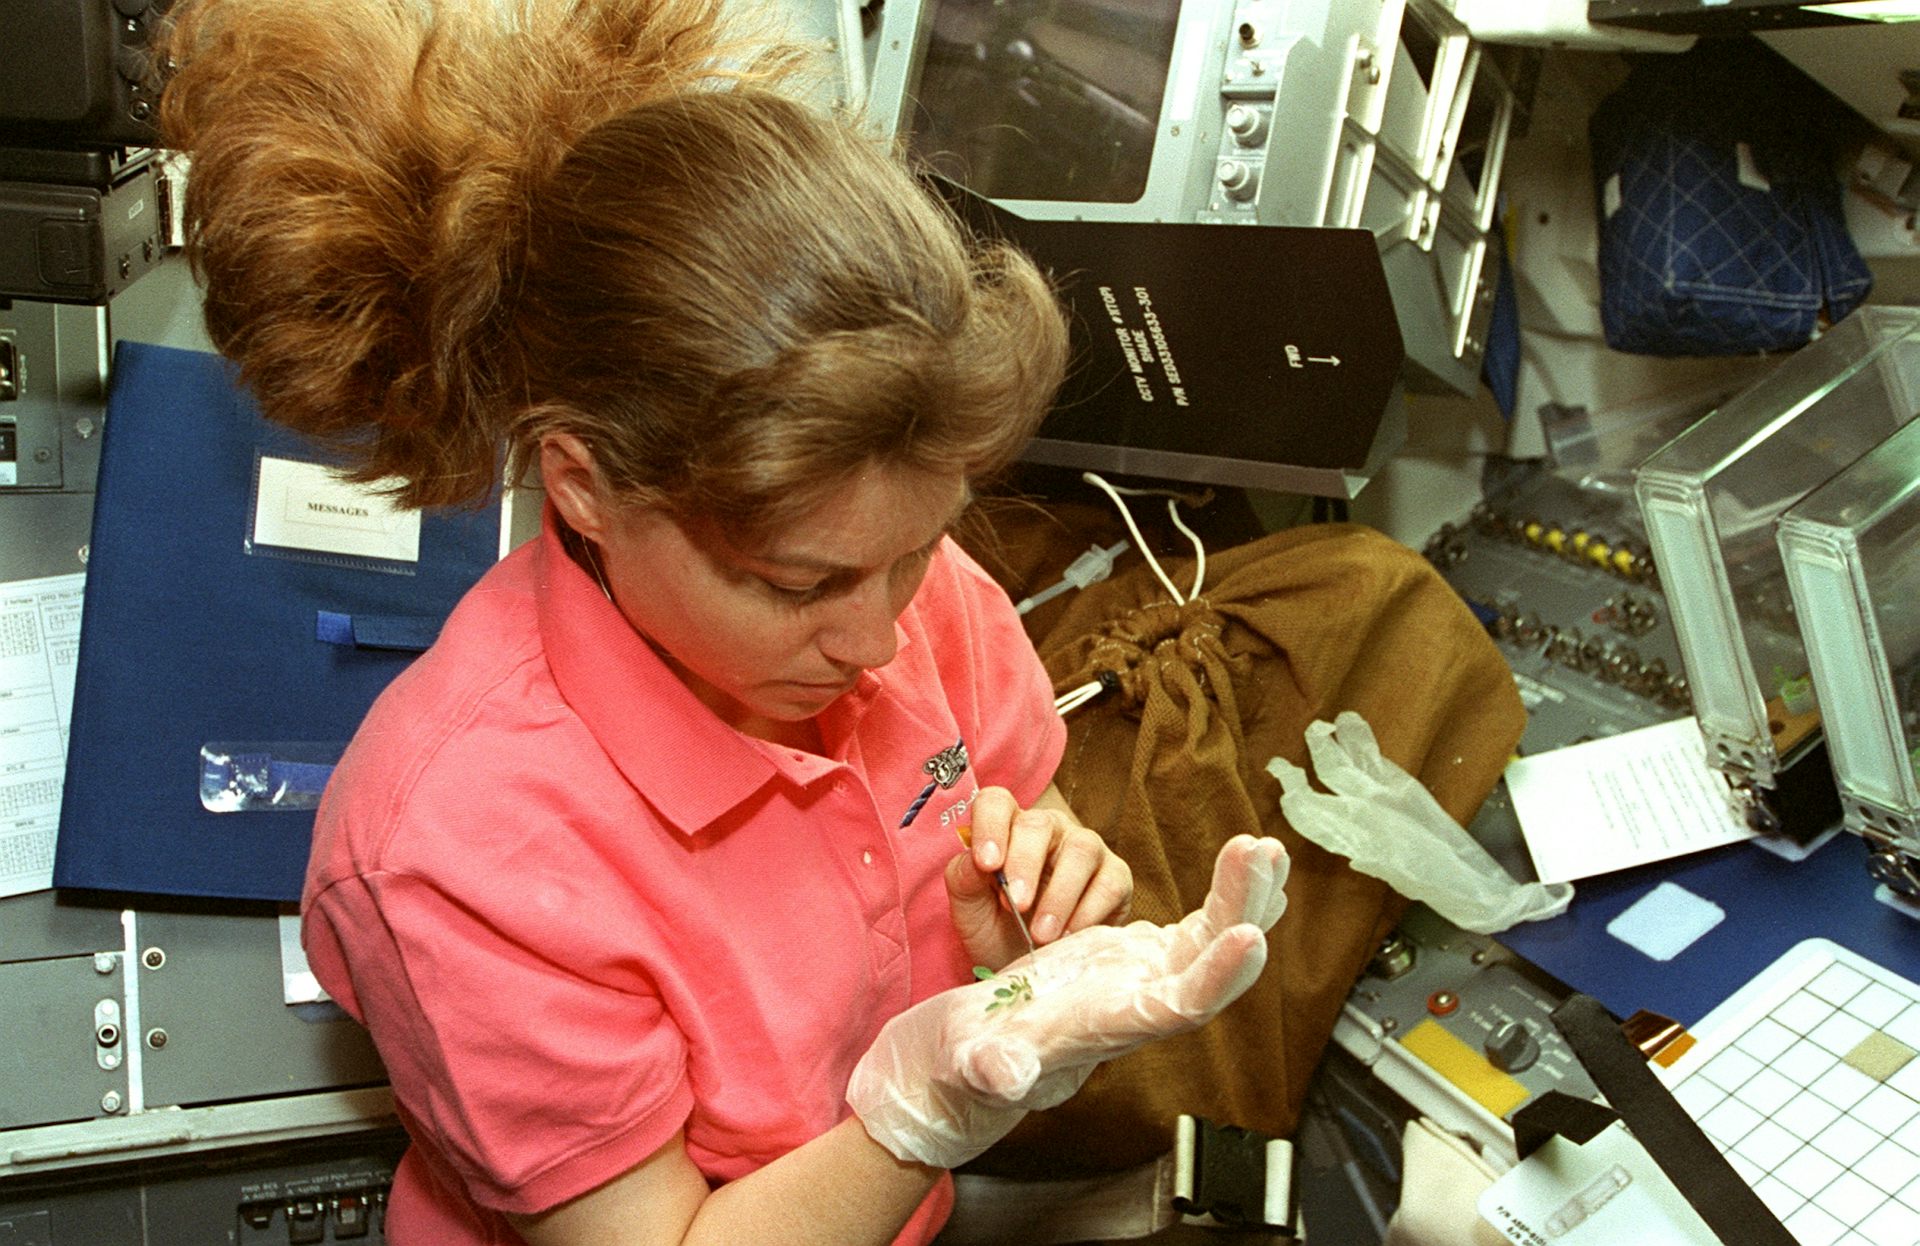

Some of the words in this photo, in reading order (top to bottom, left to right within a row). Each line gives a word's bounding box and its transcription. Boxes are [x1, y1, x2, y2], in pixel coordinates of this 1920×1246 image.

[1115, 327, 1143, 373] MONITOR
[1131, 329, 1155, 363] SHADE
[1285, 344, 1303, 368] FWD
[1134, 375, 1154, 402] CCTV
[1172, 386, 1189, 406] P/N
[308, 502, 369, 516] MESSAGES
